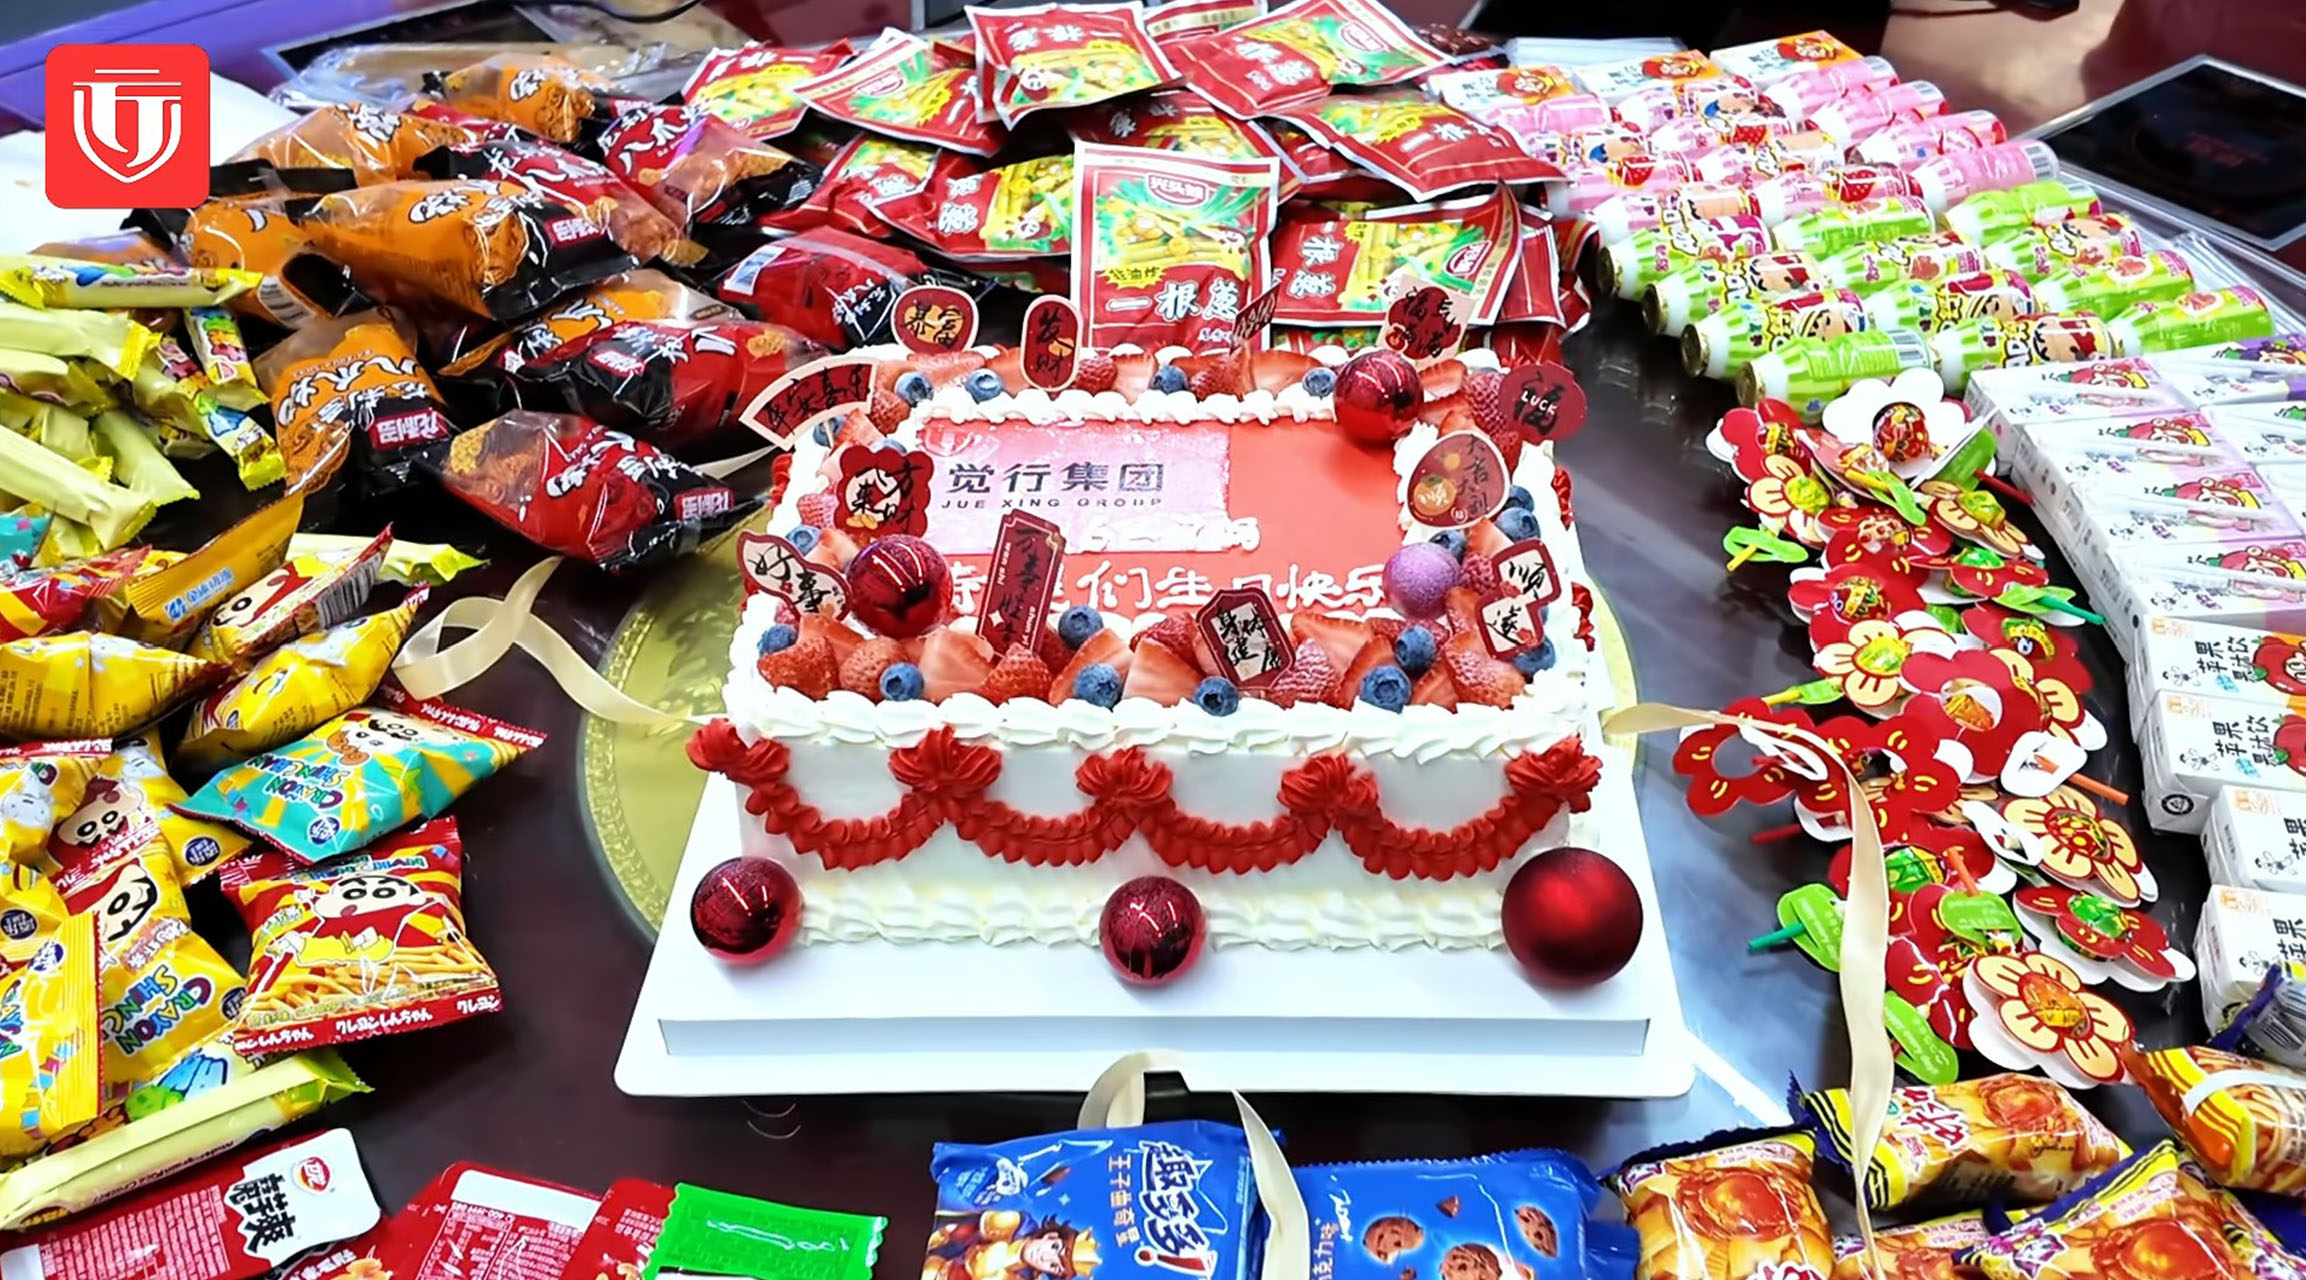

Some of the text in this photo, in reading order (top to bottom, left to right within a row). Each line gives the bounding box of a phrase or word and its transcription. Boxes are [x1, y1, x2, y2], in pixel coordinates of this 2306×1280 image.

[1520, 391, 1558, 416] LUCK
[946, 462, 1165, 495] 觉行集团
[941, 498, 987, 509] JUE
[1001, 498, 1062, 509] XING
[119, 976, 214, 1056] CRAYON
[226, 1172, 299, 1255] 魔芋爽
